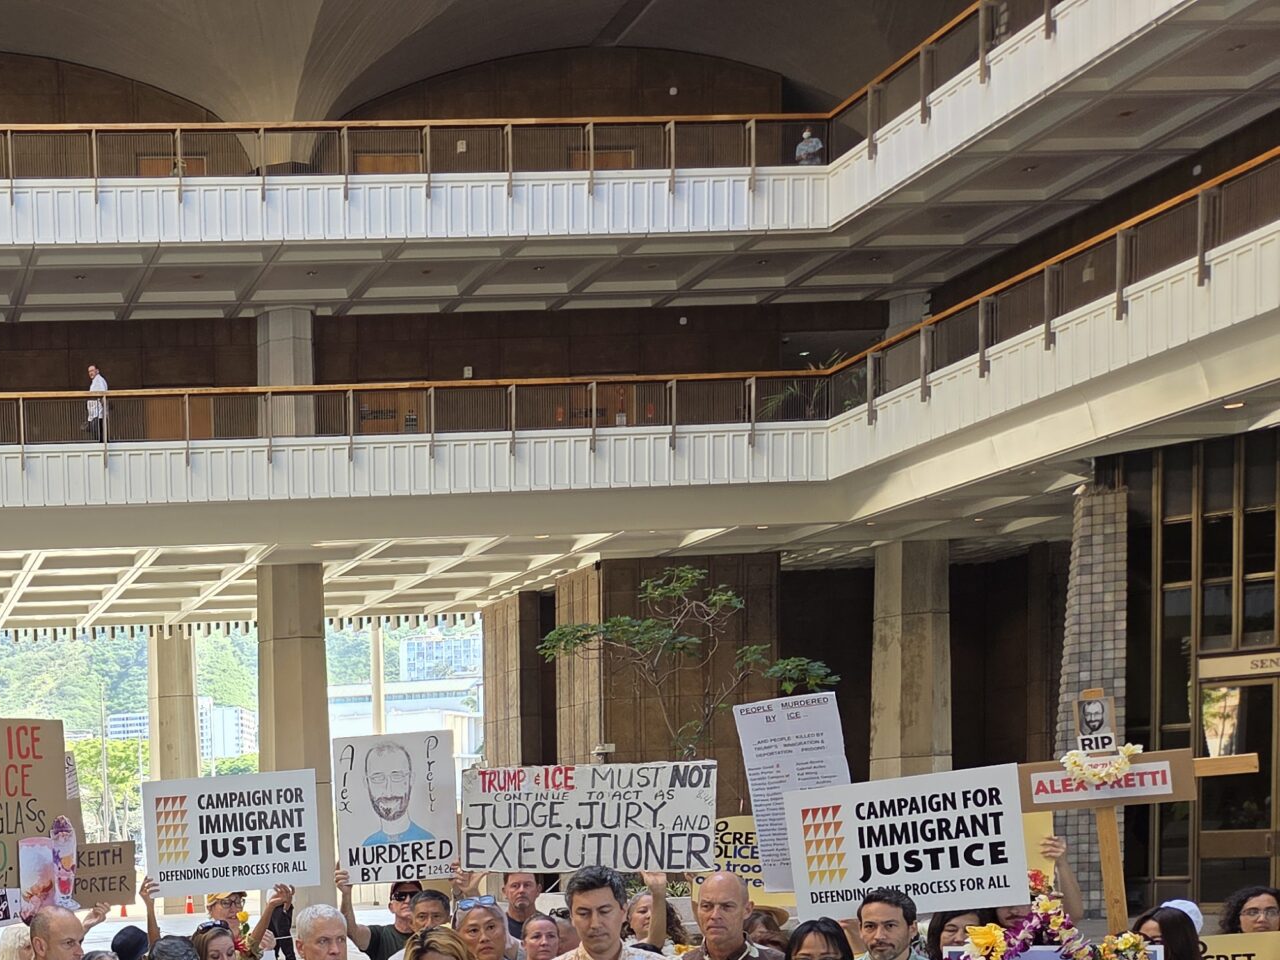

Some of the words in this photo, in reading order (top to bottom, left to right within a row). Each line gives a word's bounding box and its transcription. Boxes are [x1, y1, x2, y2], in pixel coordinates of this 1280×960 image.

[740, 705, 773, 715] PEOPLE
[781, 697, 828, 709] MURDERED
[787, 712, 800, 720] ICE
[6, 726, 43, 760] ICE
[1081, 736, 1112, 750] RIP
[478, 768, 526, 793] TRUMP
[544, 766, 576, 790] ICE
[591, 766, 666, 789] MUST
[669, 765, 716, 788] NOT
[1034, 777, 1088, 795] ALEX
[197, 790, 272, 810] CAMPAIGN
[277, 788, 304, 804] FOR
[494, 792, 569, 801] CONTINUE
[587, 791, 604, 800] TO
[614, 790, 643, 800] ACT
[655, 789, 675, 800] AS
[855, 792, 956, 820] CAMPAIGN
[962, 787, 1003, 809] FOR
[199, 808, 304, 834] IMMIGRANT
[466, 802, 573, 831] JUDGE,
[575, 801, 667, 830] JURY,
[672, 815, 710, 831] AND
[857, 812, 1004, 848] IMMIGRANT
[76, 848, 122, 868] KEITH
[198, 832, 307, 864] JUSTICE
[349, 840, 453, 866] MURDERED
[465, 832, 714, 869] EXECUTIONER
[159, 867, 209, 882] DEFENDING
[212, 866, 230, 878] DUE
[232, 863, 270, 877] PROCESS
[273, 862, 289, 874] FOR
[292, 861, 307, 872] ALL
[361, 867, 382, 881] BY
[397, 864, 426, 880] ICE
[726, 861, 762, 873] troo
[859, 841, 1008, 883] JUSTICE
[74, 875, 130, 894] PORTER
[905, 880, 956, 896] PROCESS
[960, 878, 984, 893] FOR
[988, 875, 1010, 889] ALL
